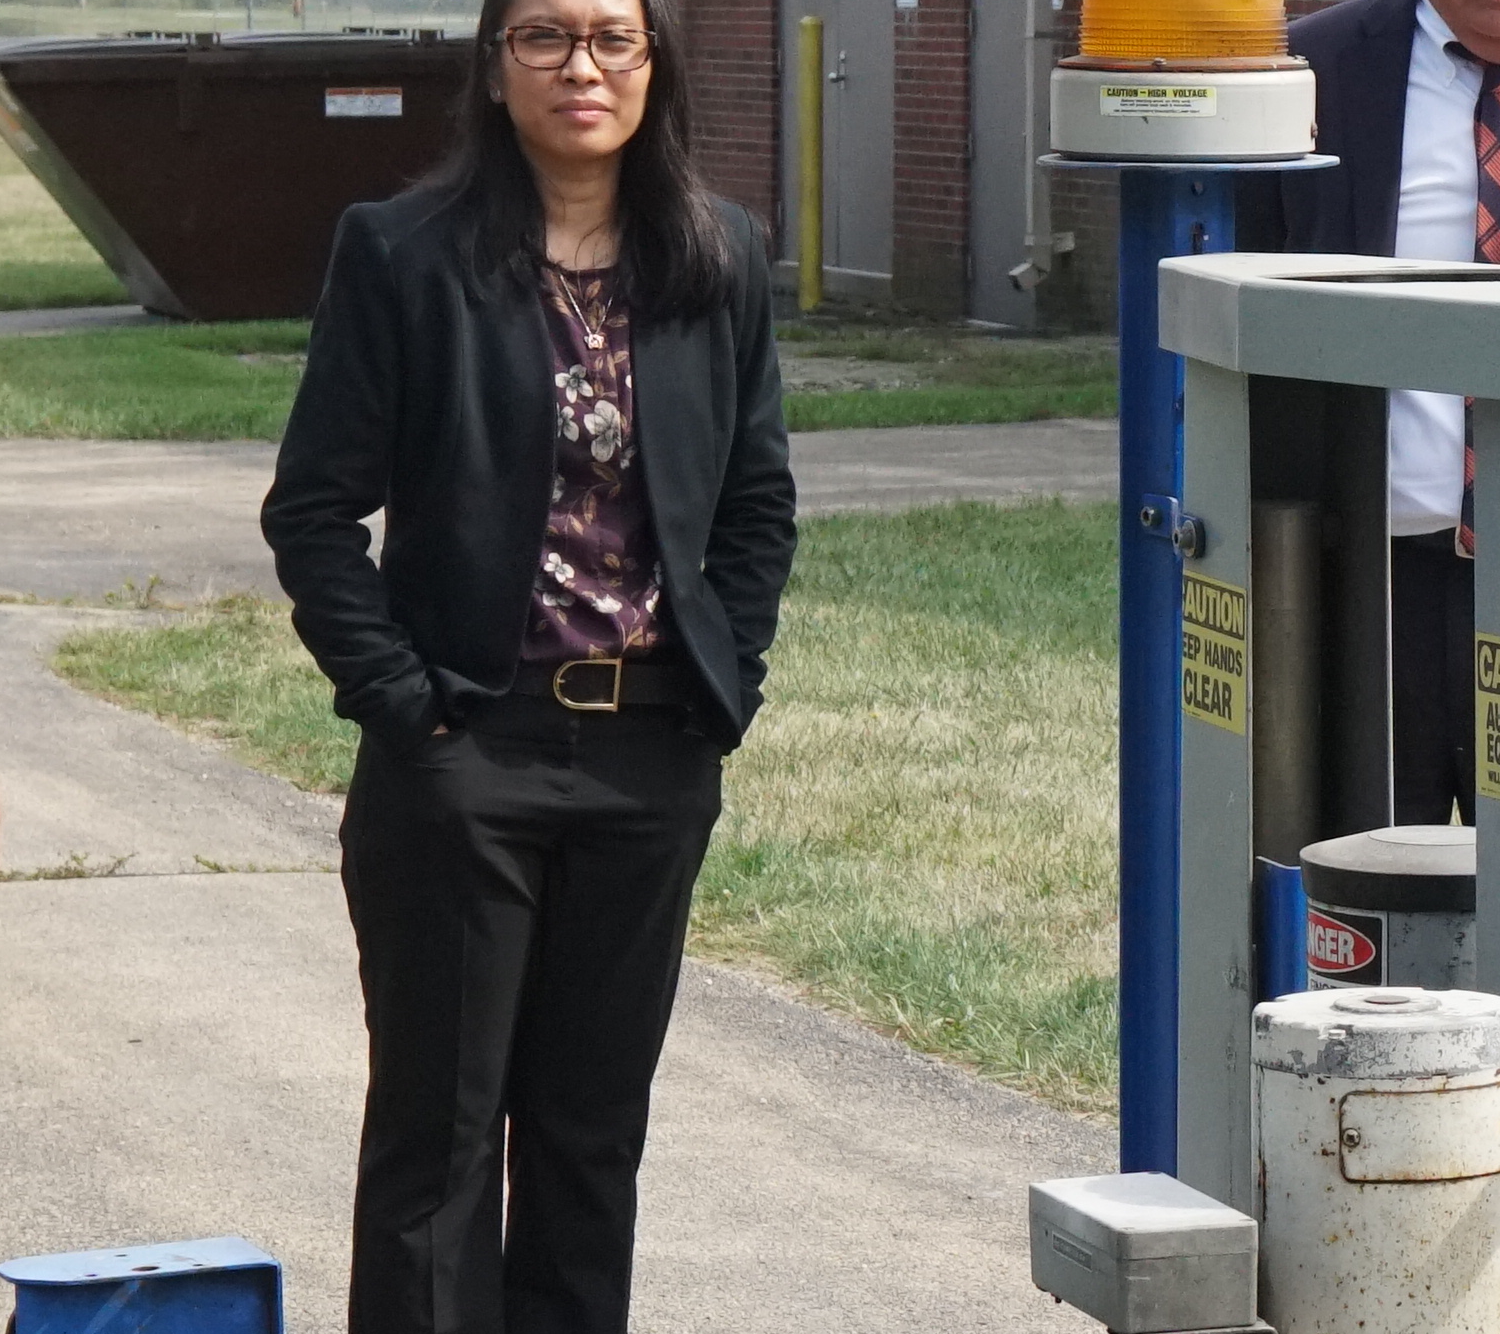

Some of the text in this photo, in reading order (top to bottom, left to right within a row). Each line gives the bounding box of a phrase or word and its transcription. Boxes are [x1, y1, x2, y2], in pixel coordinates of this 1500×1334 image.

[1106, 88, 1138, 97] CAUTION
[1147, 88, 1167, 97] HIGH
[1172, 89, 1208, 98] VOLTAGE
[1183, 581, 1243, 636] AUTION
[1183, 632, 1243, 677] EEP HANDS
[1183, 668, 1232, 721] CLEAR
[1488, 770, 1500, 785] WILL
[1308, 921, 1355, 966] NGER
